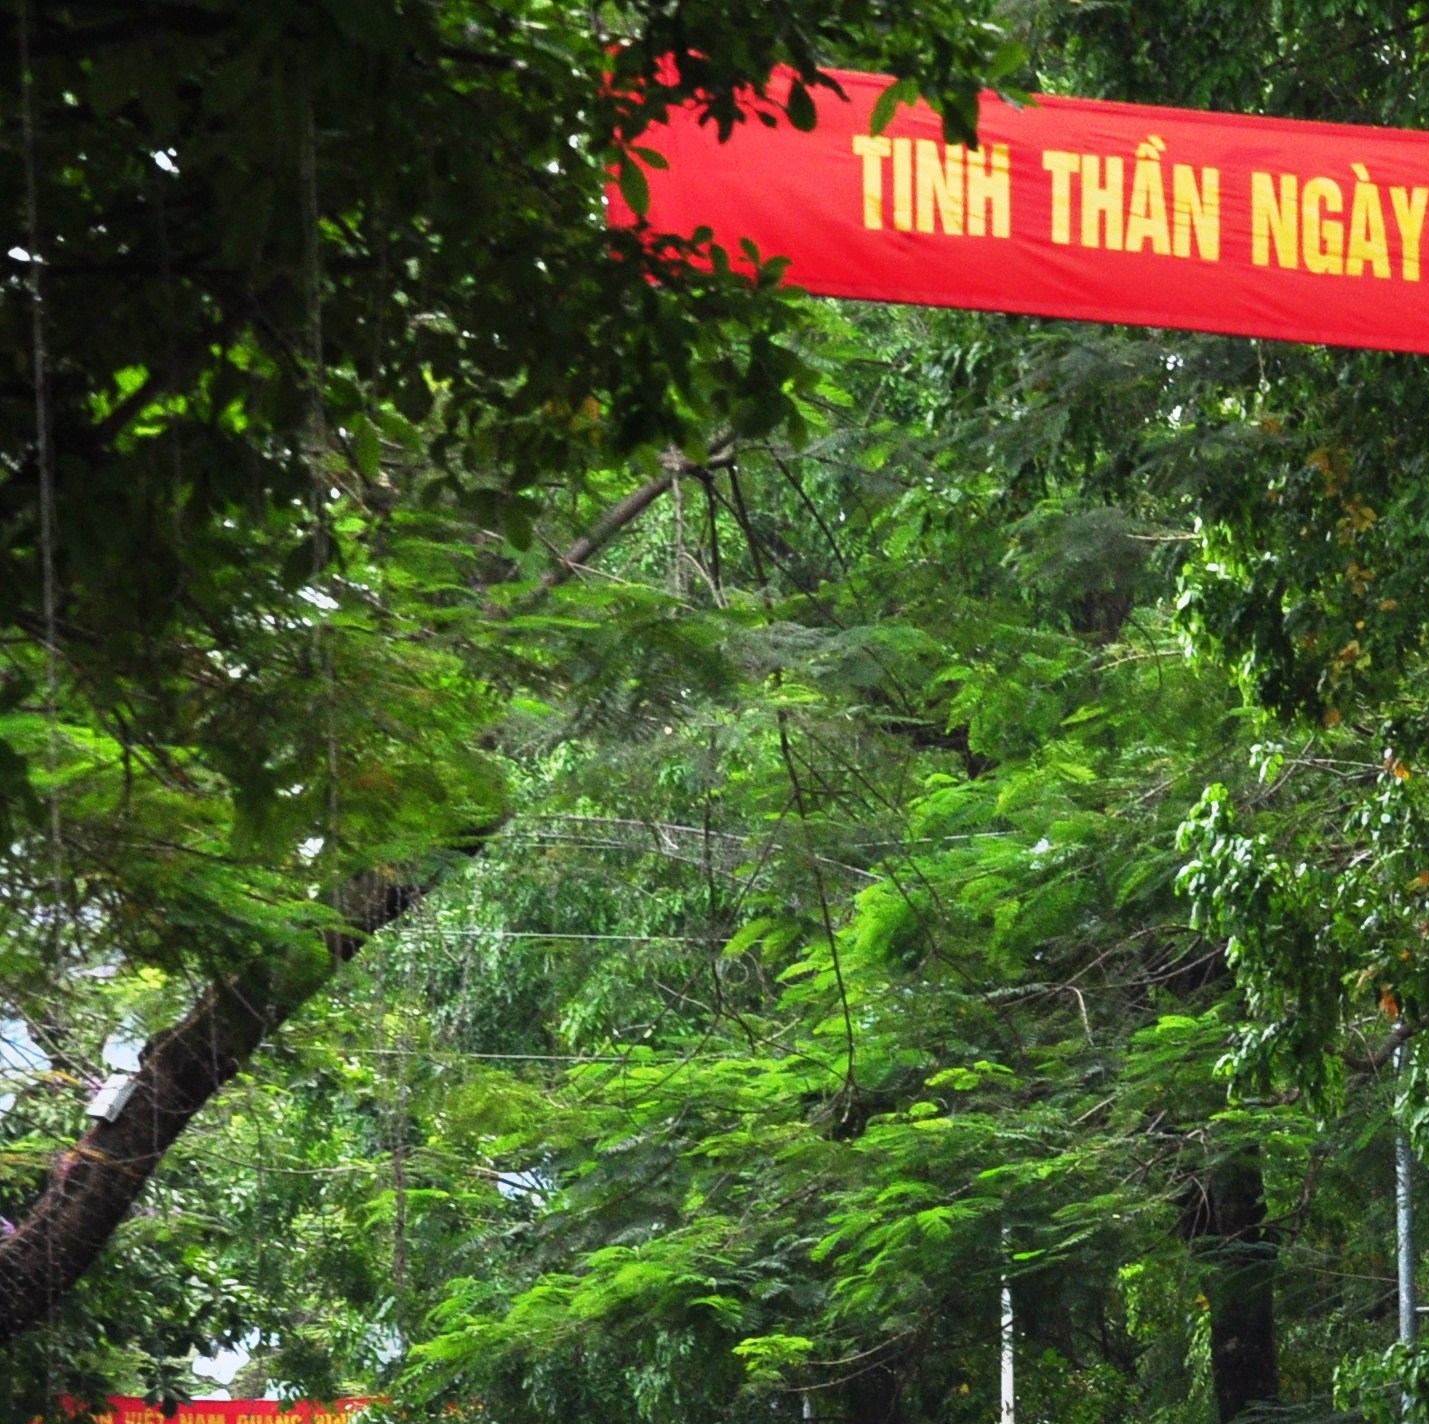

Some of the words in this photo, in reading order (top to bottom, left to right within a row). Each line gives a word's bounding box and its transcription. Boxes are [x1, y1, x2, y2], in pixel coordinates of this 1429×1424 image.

[852, 134, 1011, 239] TINH
[1042, 131, 1220, 262] THẦN
[1250, 161, 1429, 282] NGÀY
